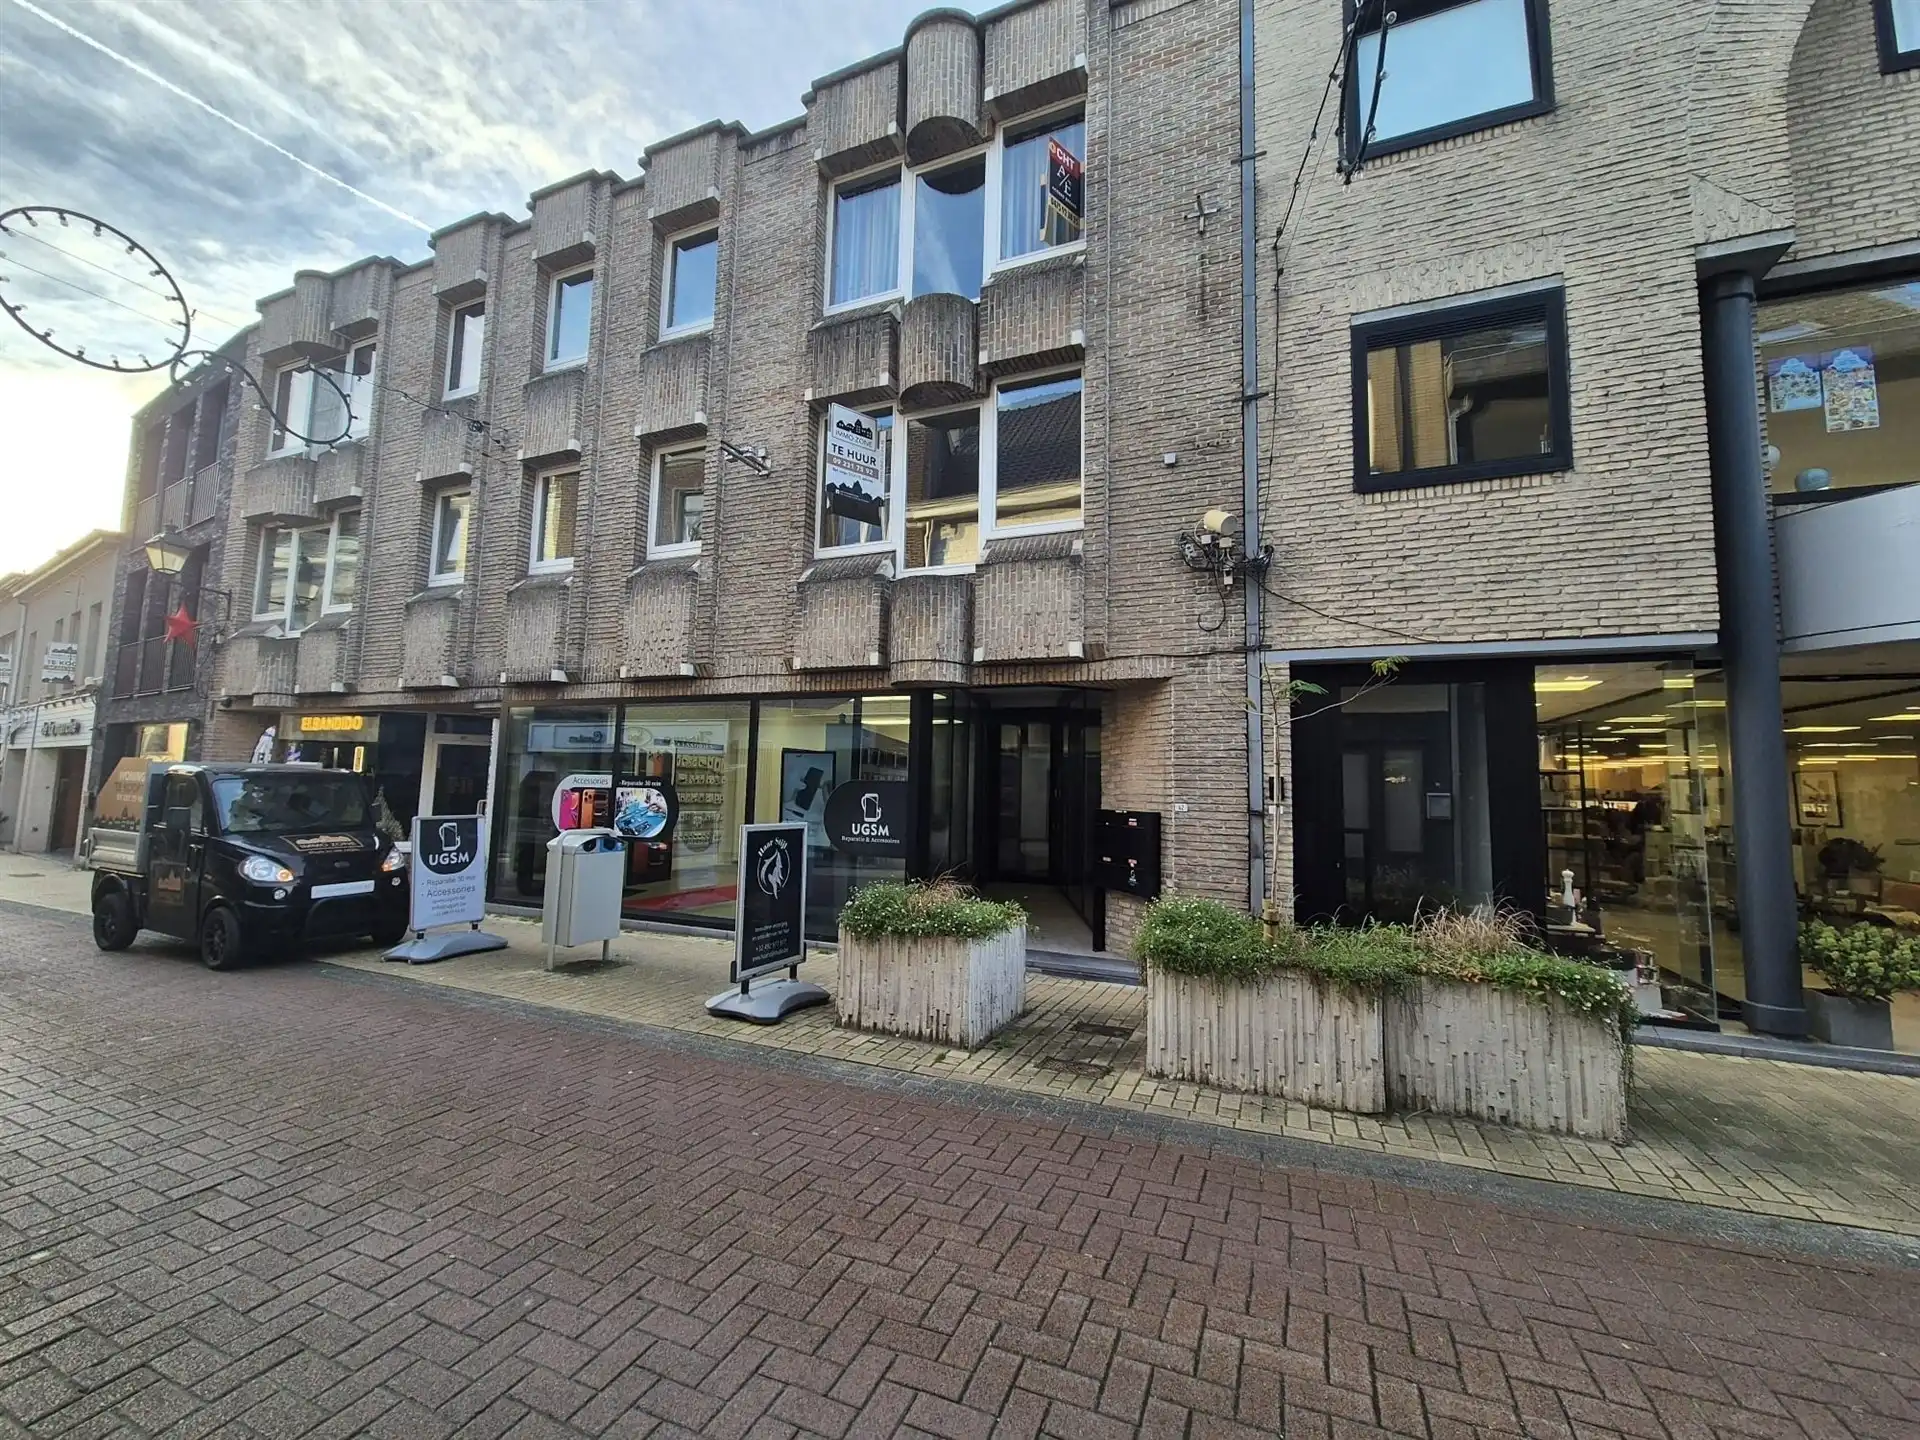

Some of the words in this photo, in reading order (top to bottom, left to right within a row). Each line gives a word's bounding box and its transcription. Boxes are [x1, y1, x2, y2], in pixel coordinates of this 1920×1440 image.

[831, 443, 844, 456] TE
[847, 448, 877, 466] HUUR
[852, 823, 890, 836] UGSM
[841, 835, 865, 843] Reparatie
[758, 840, 773, 857] Haar
[428, 851, 469, 866] UGSM
[427, 885, 476, 898] Accessories
